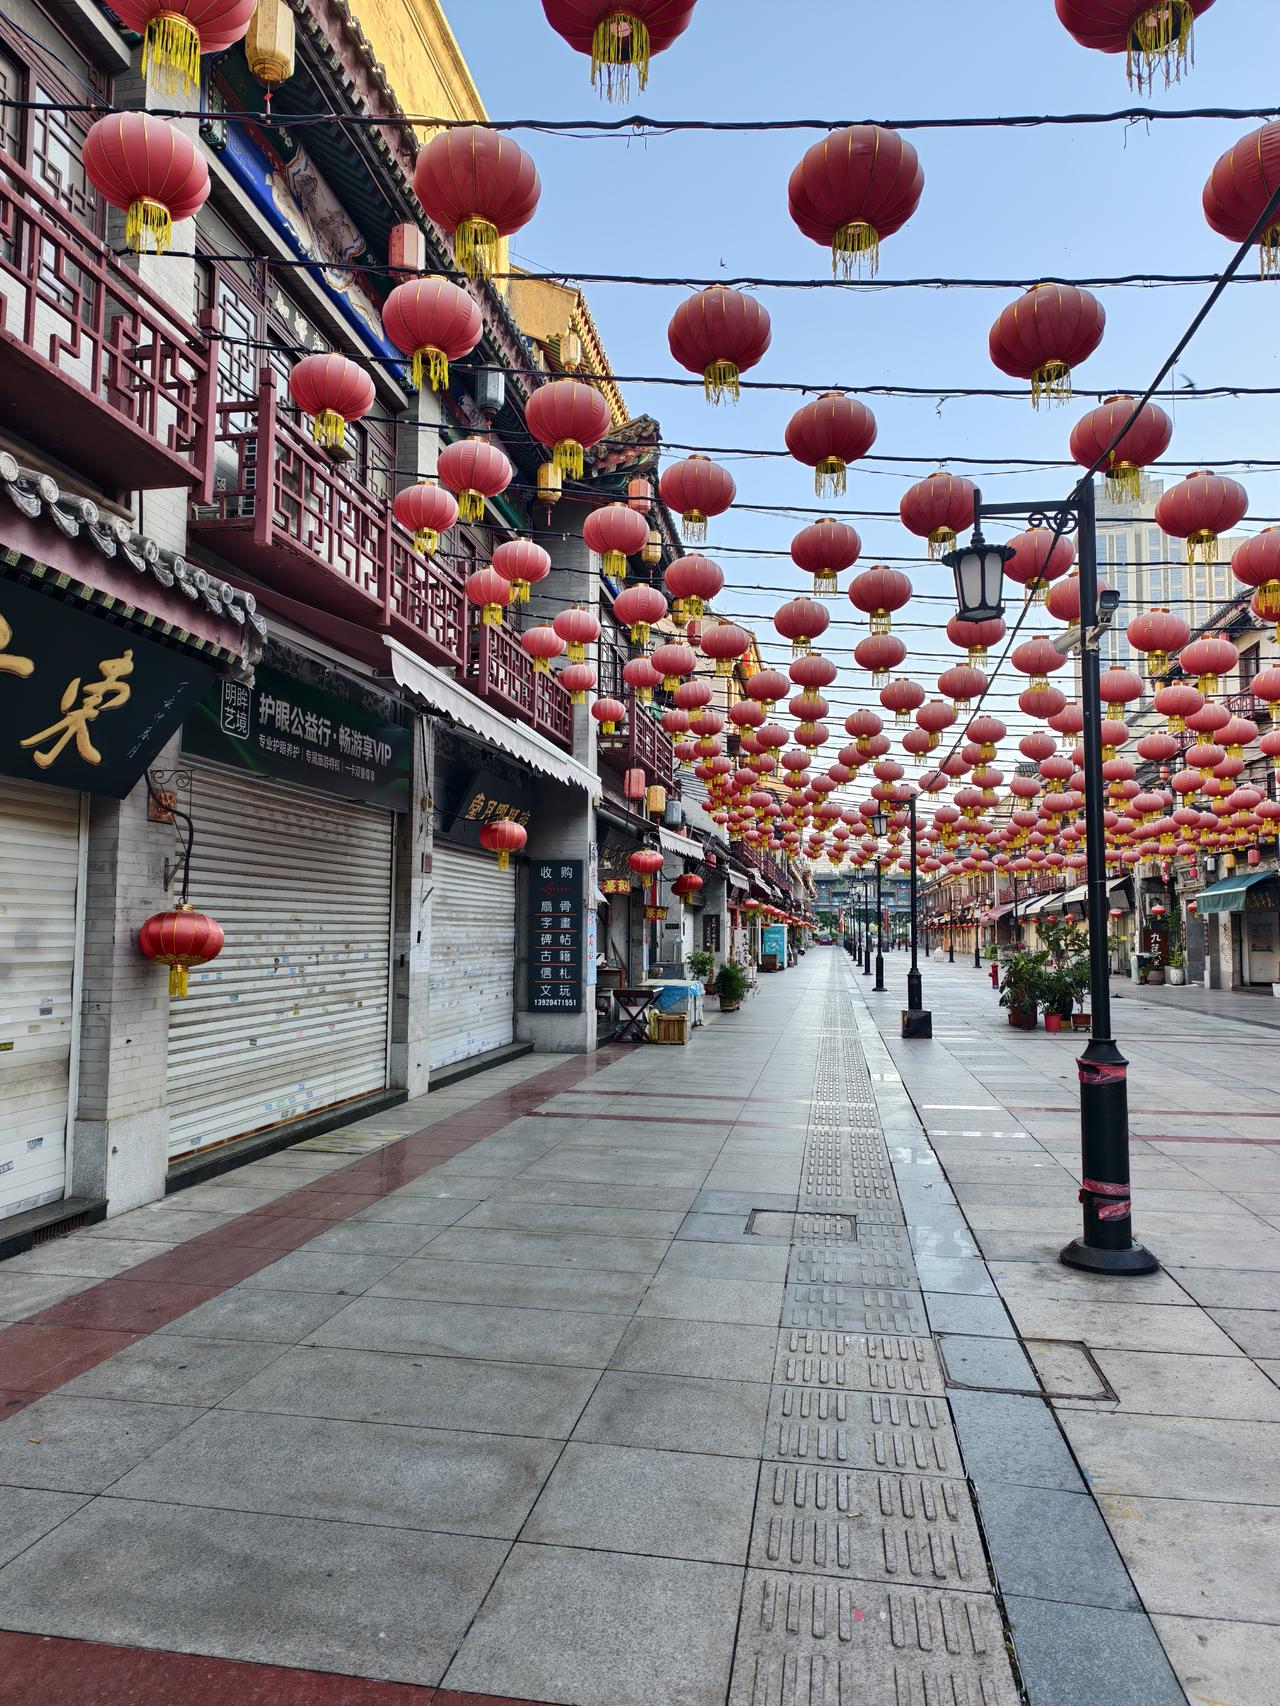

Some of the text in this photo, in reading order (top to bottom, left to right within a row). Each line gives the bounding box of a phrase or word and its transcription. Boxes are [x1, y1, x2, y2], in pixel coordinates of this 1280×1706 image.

[225, 682, 249, 711] 明眸
[224, 706, 248, 734] 艺境
[258, 734, 300, 759] 专业护眼养护
[540, 866, 573, 879] 收购
[540, 901, 572, 913] 扇骨
[540, 934, 571, 946] 碑帖
[540, 950, 571, 962] 古籍
[540, 967, 571, 979] 信札
[540, 985, 571, 997] 文玩
